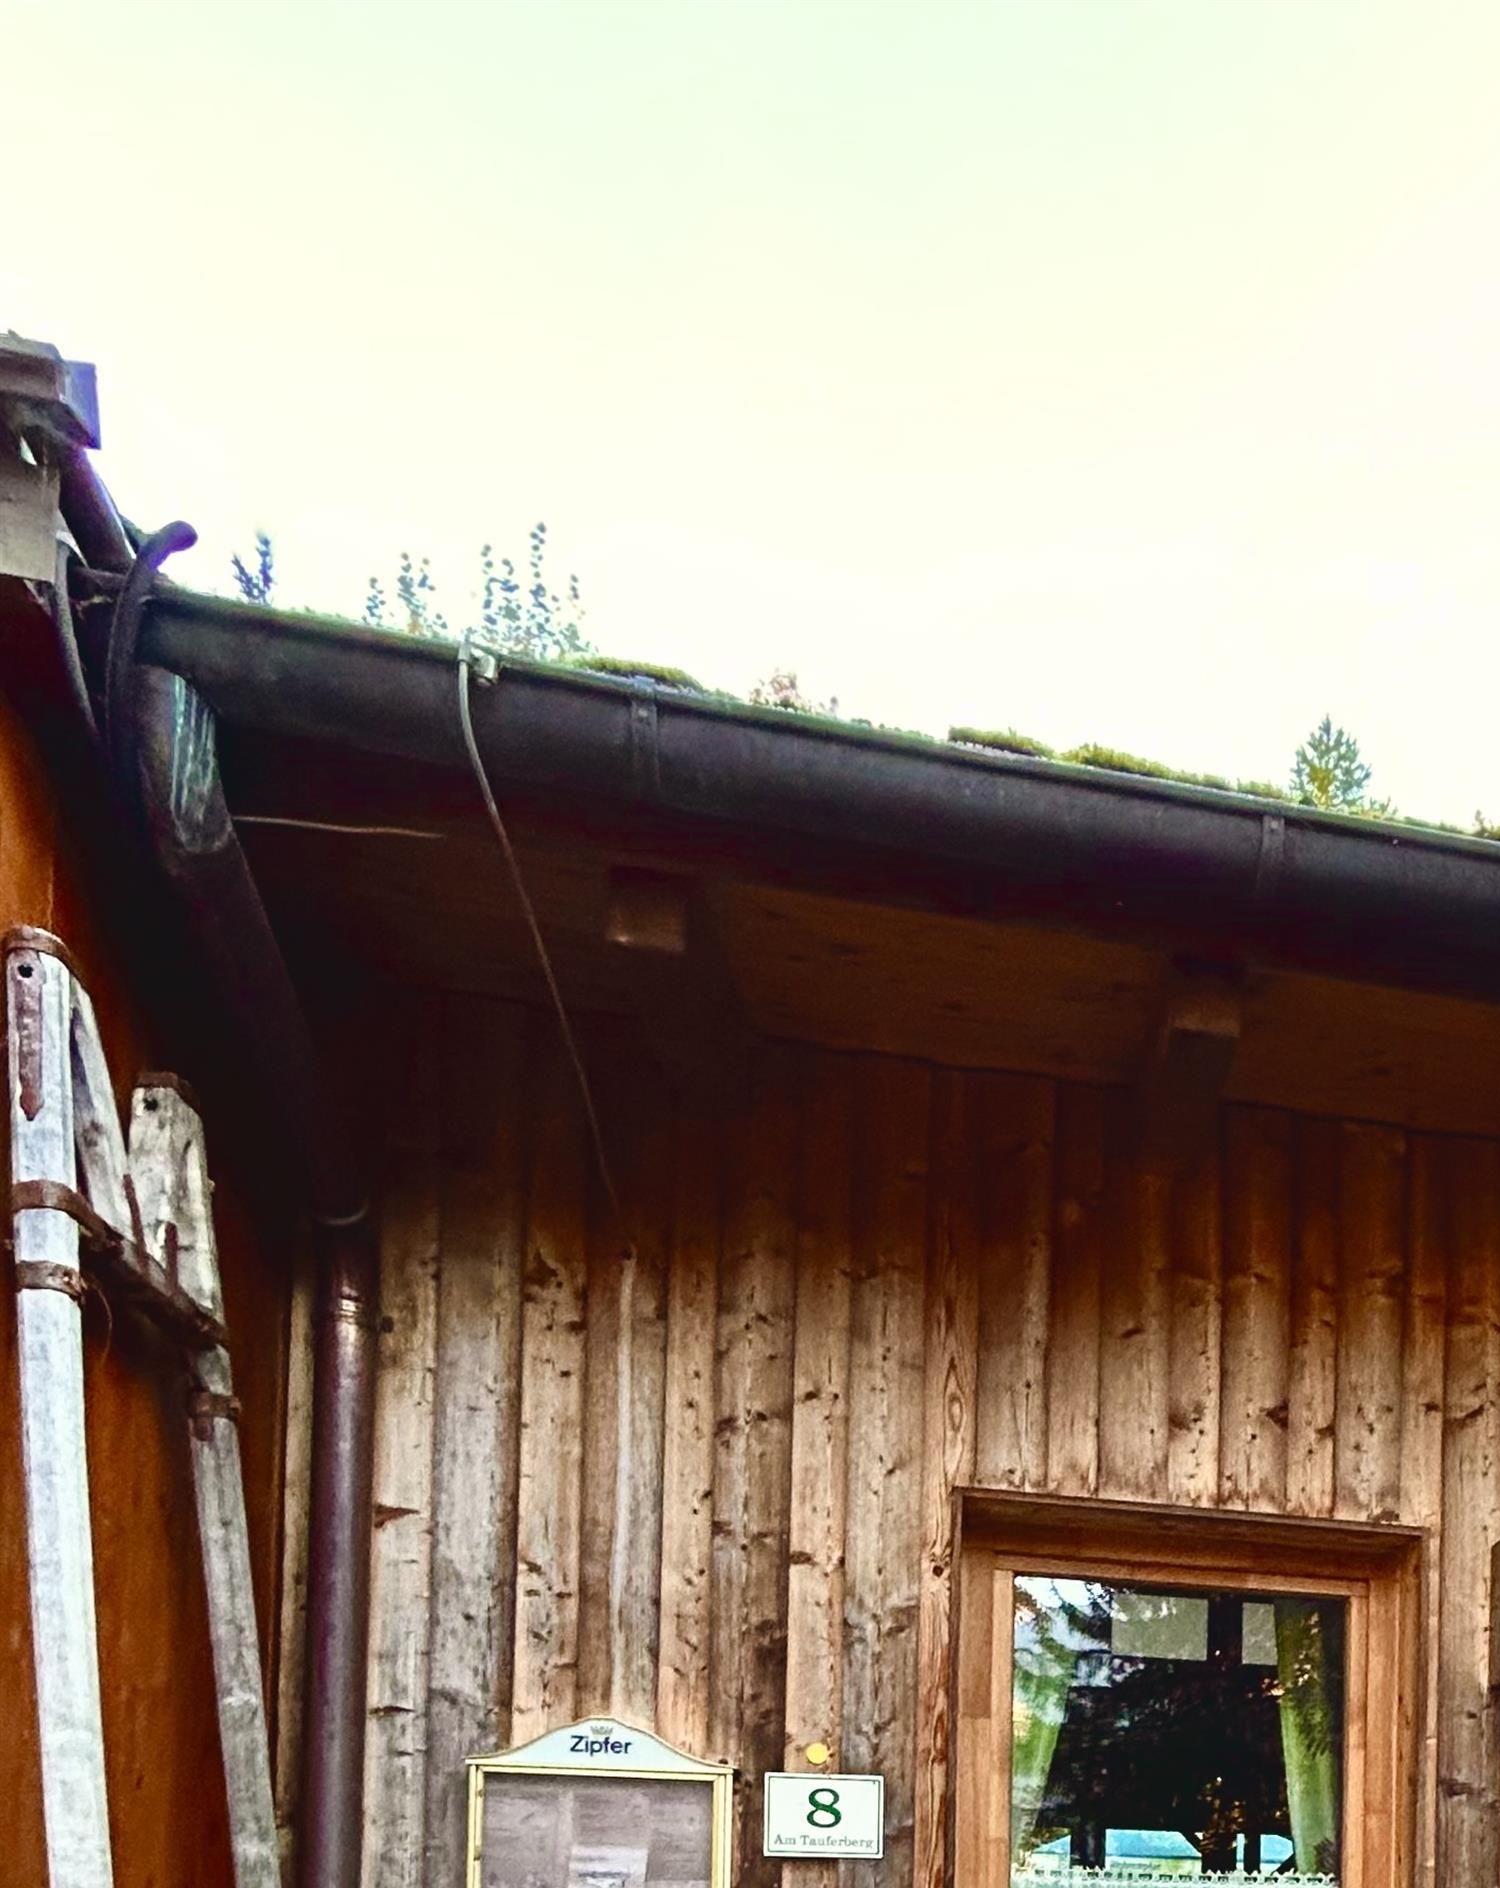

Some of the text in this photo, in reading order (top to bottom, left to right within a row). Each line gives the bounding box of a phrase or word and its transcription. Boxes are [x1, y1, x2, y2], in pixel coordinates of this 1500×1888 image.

[569, 1734, 632, 1757] Zipfer
[806, 1788, 842, 1828] 8
[773, 1834, 874, 1849] Am Tauferberg
